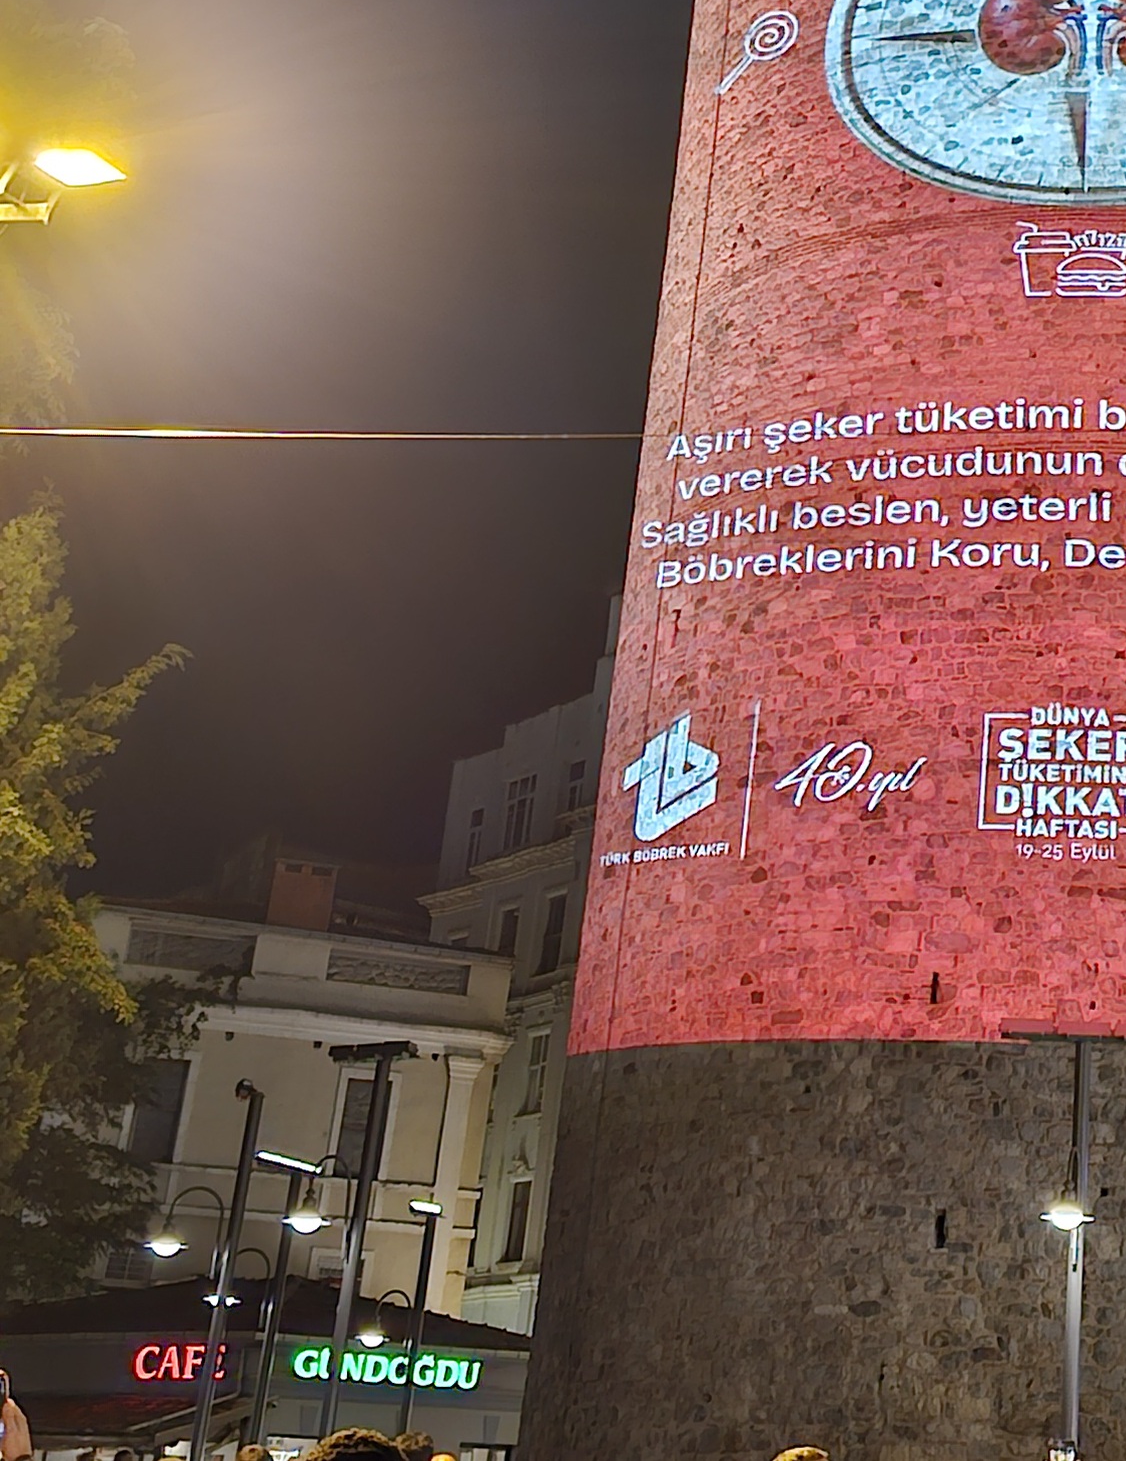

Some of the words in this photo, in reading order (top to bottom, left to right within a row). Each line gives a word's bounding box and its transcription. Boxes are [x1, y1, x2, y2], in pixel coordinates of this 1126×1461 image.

[666, 425, 751, 464] Aşırı
[763, 409, 884, 454] şeker
[895, 397, 1085, 435] tüketimi
[677, 455, 834, 501] vererek
[845, 445, 1103, 483] vücudunun
[640, 503, 779, 550] Sağlıklı
[792, 495, 949, 531] beslen,
[962, 490, 1112, 528] yeterli
[655, 537, 917, 589] Böbreklerini
[931, 538, 1050, 573] Koru,
[1030, 702, 1110, 727] DÜNYA
[1015, 818, 1119, 839] HAFTASI
[688, 842, 730, 857] VAKFI
[1016, 843, 1063, 860] 19-25
[1070, 842, 1117, 863] Eylül
[294, 1348, 480, 1389] GNDOĞDU
